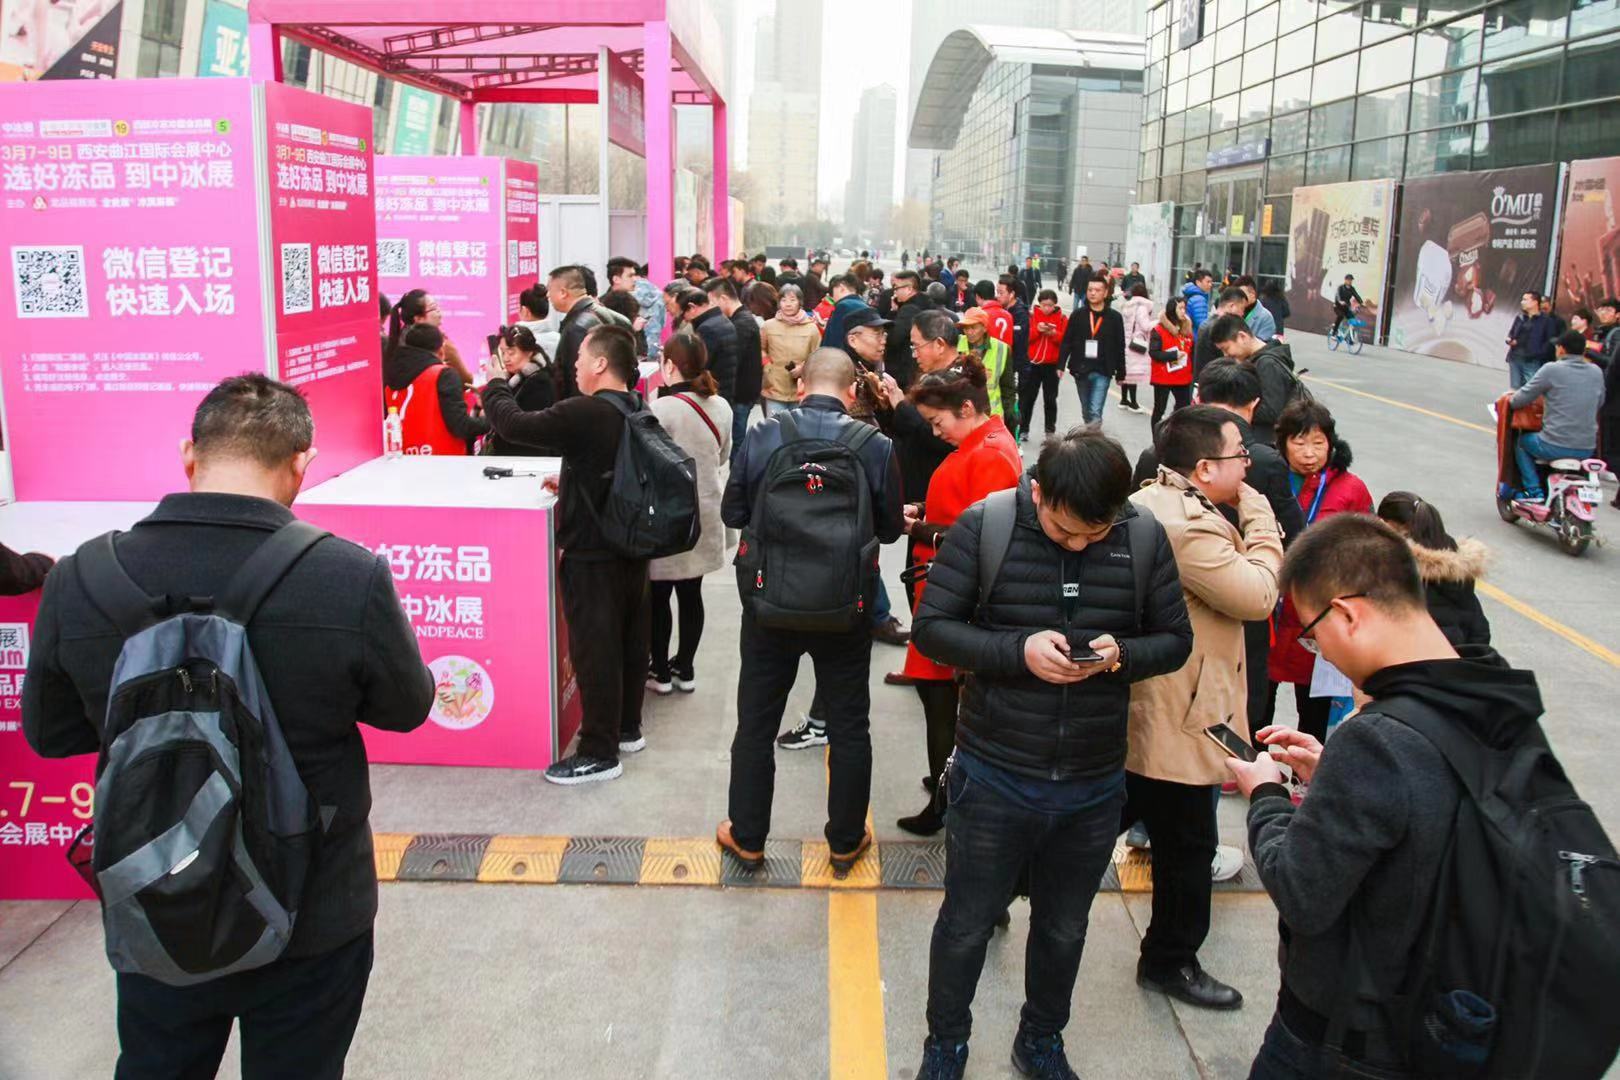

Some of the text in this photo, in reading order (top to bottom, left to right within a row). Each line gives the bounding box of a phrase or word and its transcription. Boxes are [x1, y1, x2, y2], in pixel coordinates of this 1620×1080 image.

[209, 25, 249, 76] 亚
[77, 142, 232, 159] 西安曲江国际会展中心
[3, 160, 234, 191] 选好冻品 到中冰展
[277, 162, 368, 196] 选好冻品 到中冰展
[102, 246, 233, 280] 微信登记
[316, 244, 369, 274] 微信登记
[417, 240, 488, 258] 微信登记
[418, 260, 488, 278] 快速入场
[105, 283, 235, 317] 快速入场
[318, 274, 371, 308] 快速入场
[358, 543, 491, 582] 好冻品
[400, 594, 483, 625] 中冰展
